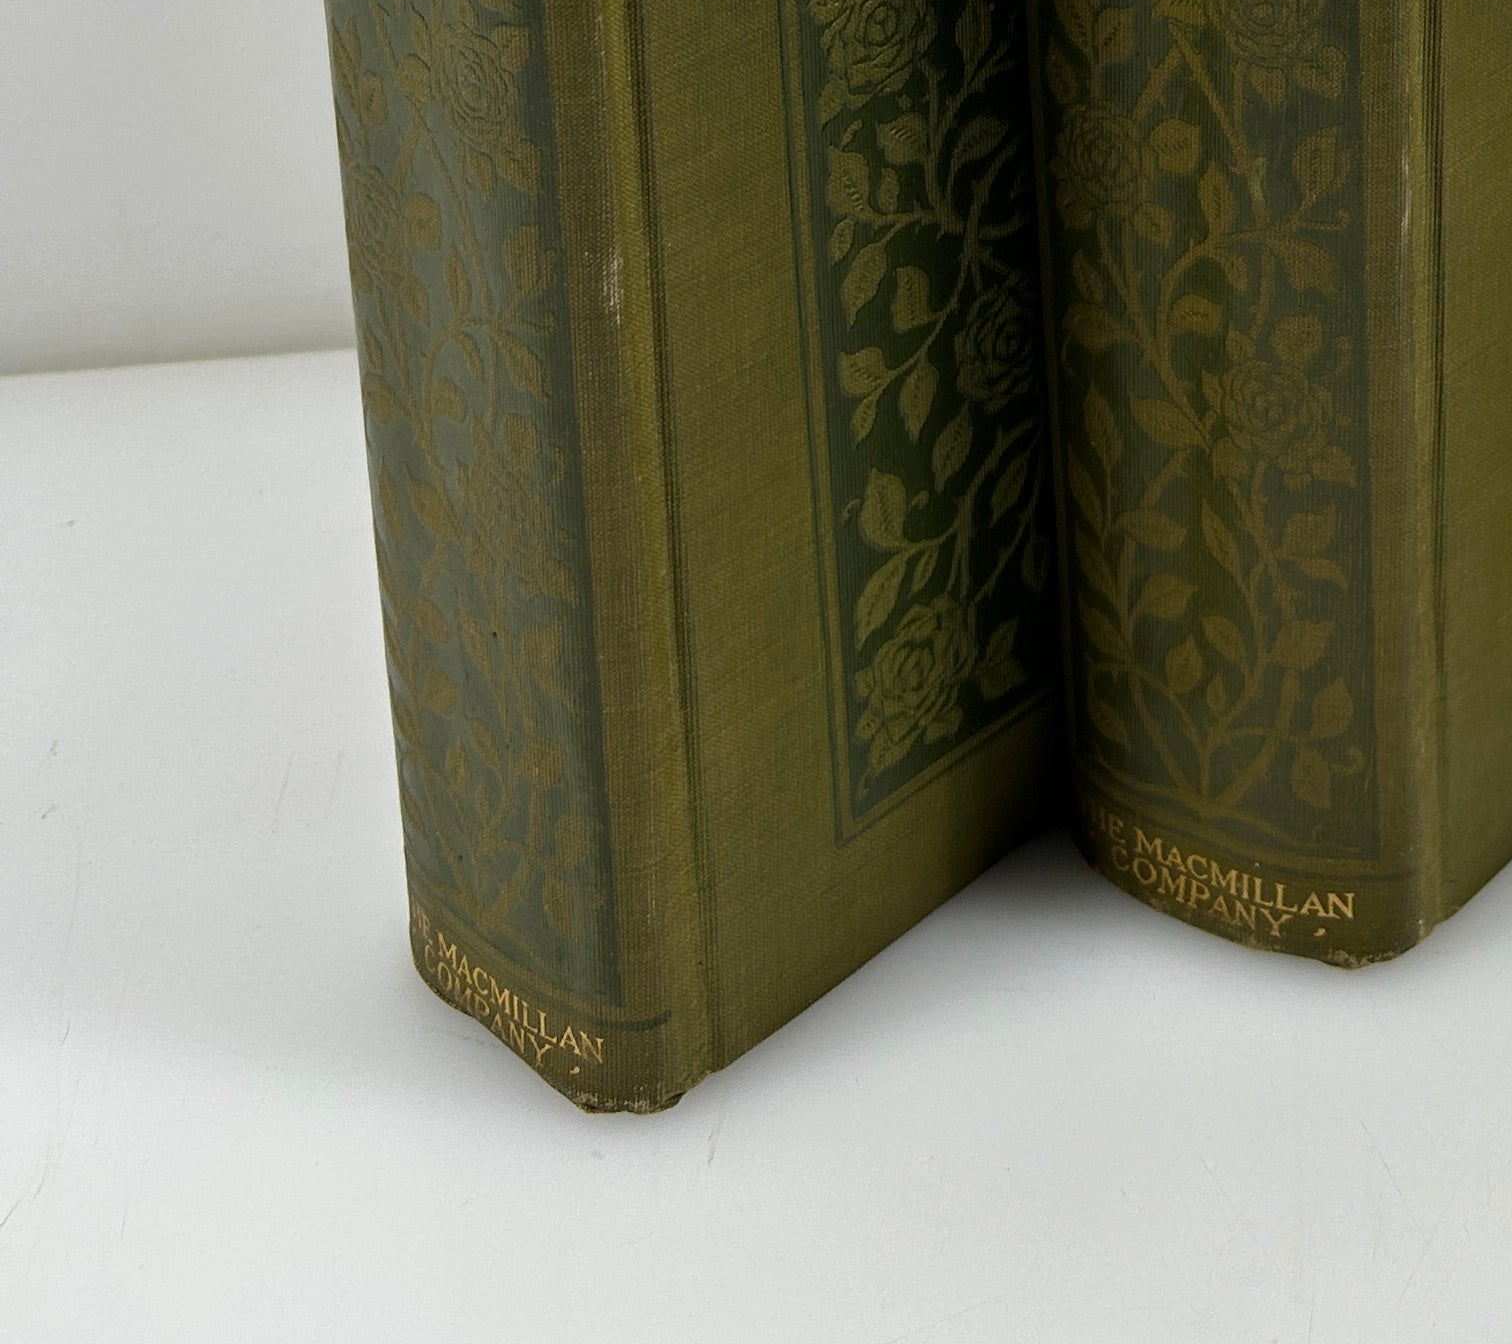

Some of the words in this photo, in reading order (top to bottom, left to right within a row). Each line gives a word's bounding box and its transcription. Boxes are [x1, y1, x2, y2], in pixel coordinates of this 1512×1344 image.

[1110, 844, 1294, 939] COMPANY
[1132, 825, 1356, 920] MACMILLAN
[436, 929, 605, 1065] MACMILLAN
